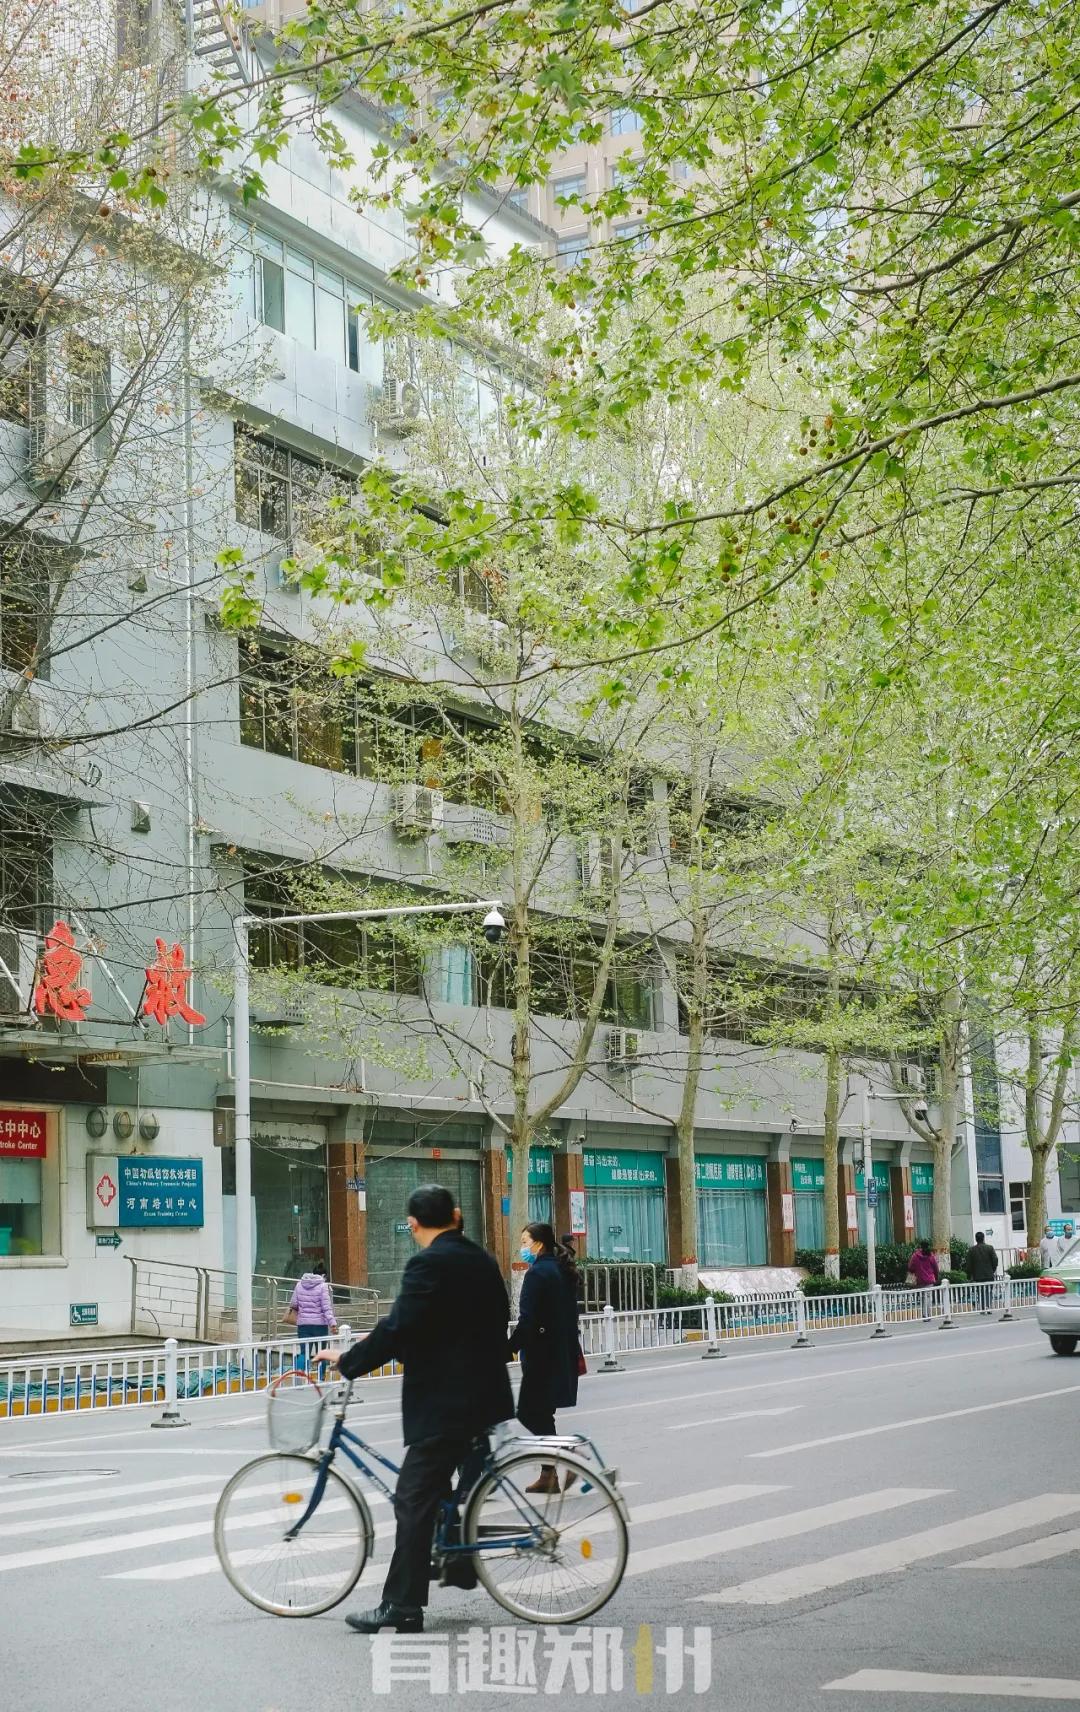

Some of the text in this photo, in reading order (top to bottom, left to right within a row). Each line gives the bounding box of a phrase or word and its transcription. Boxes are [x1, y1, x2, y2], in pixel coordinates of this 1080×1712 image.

[35, 920, 206, 1025] 急救
[18, 1141, 38, 1150] Center
[126, 1197, 197, 1210] 河南培训中心
